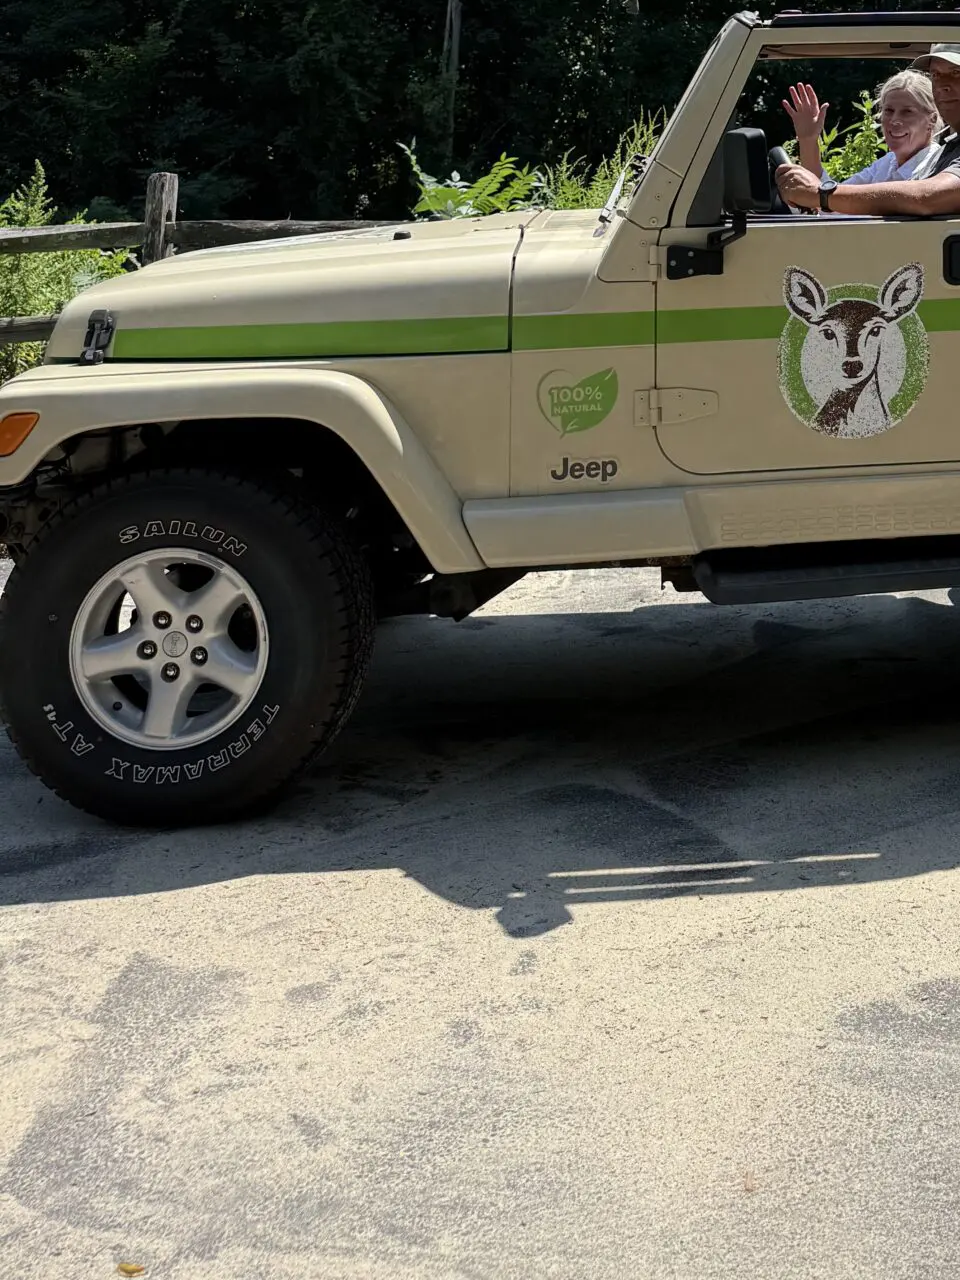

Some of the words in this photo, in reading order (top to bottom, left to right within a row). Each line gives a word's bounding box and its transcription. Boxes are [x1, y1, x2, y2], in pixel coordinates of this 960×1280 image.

[550, 385, 603, 404] 100%
[553, 403, 603, 415] NATURAL
[550, 457, 618, 482] Jeep
[118, 520, 248, 557] SAILUN
[104, 701, 280, 784] TERRAMAX
